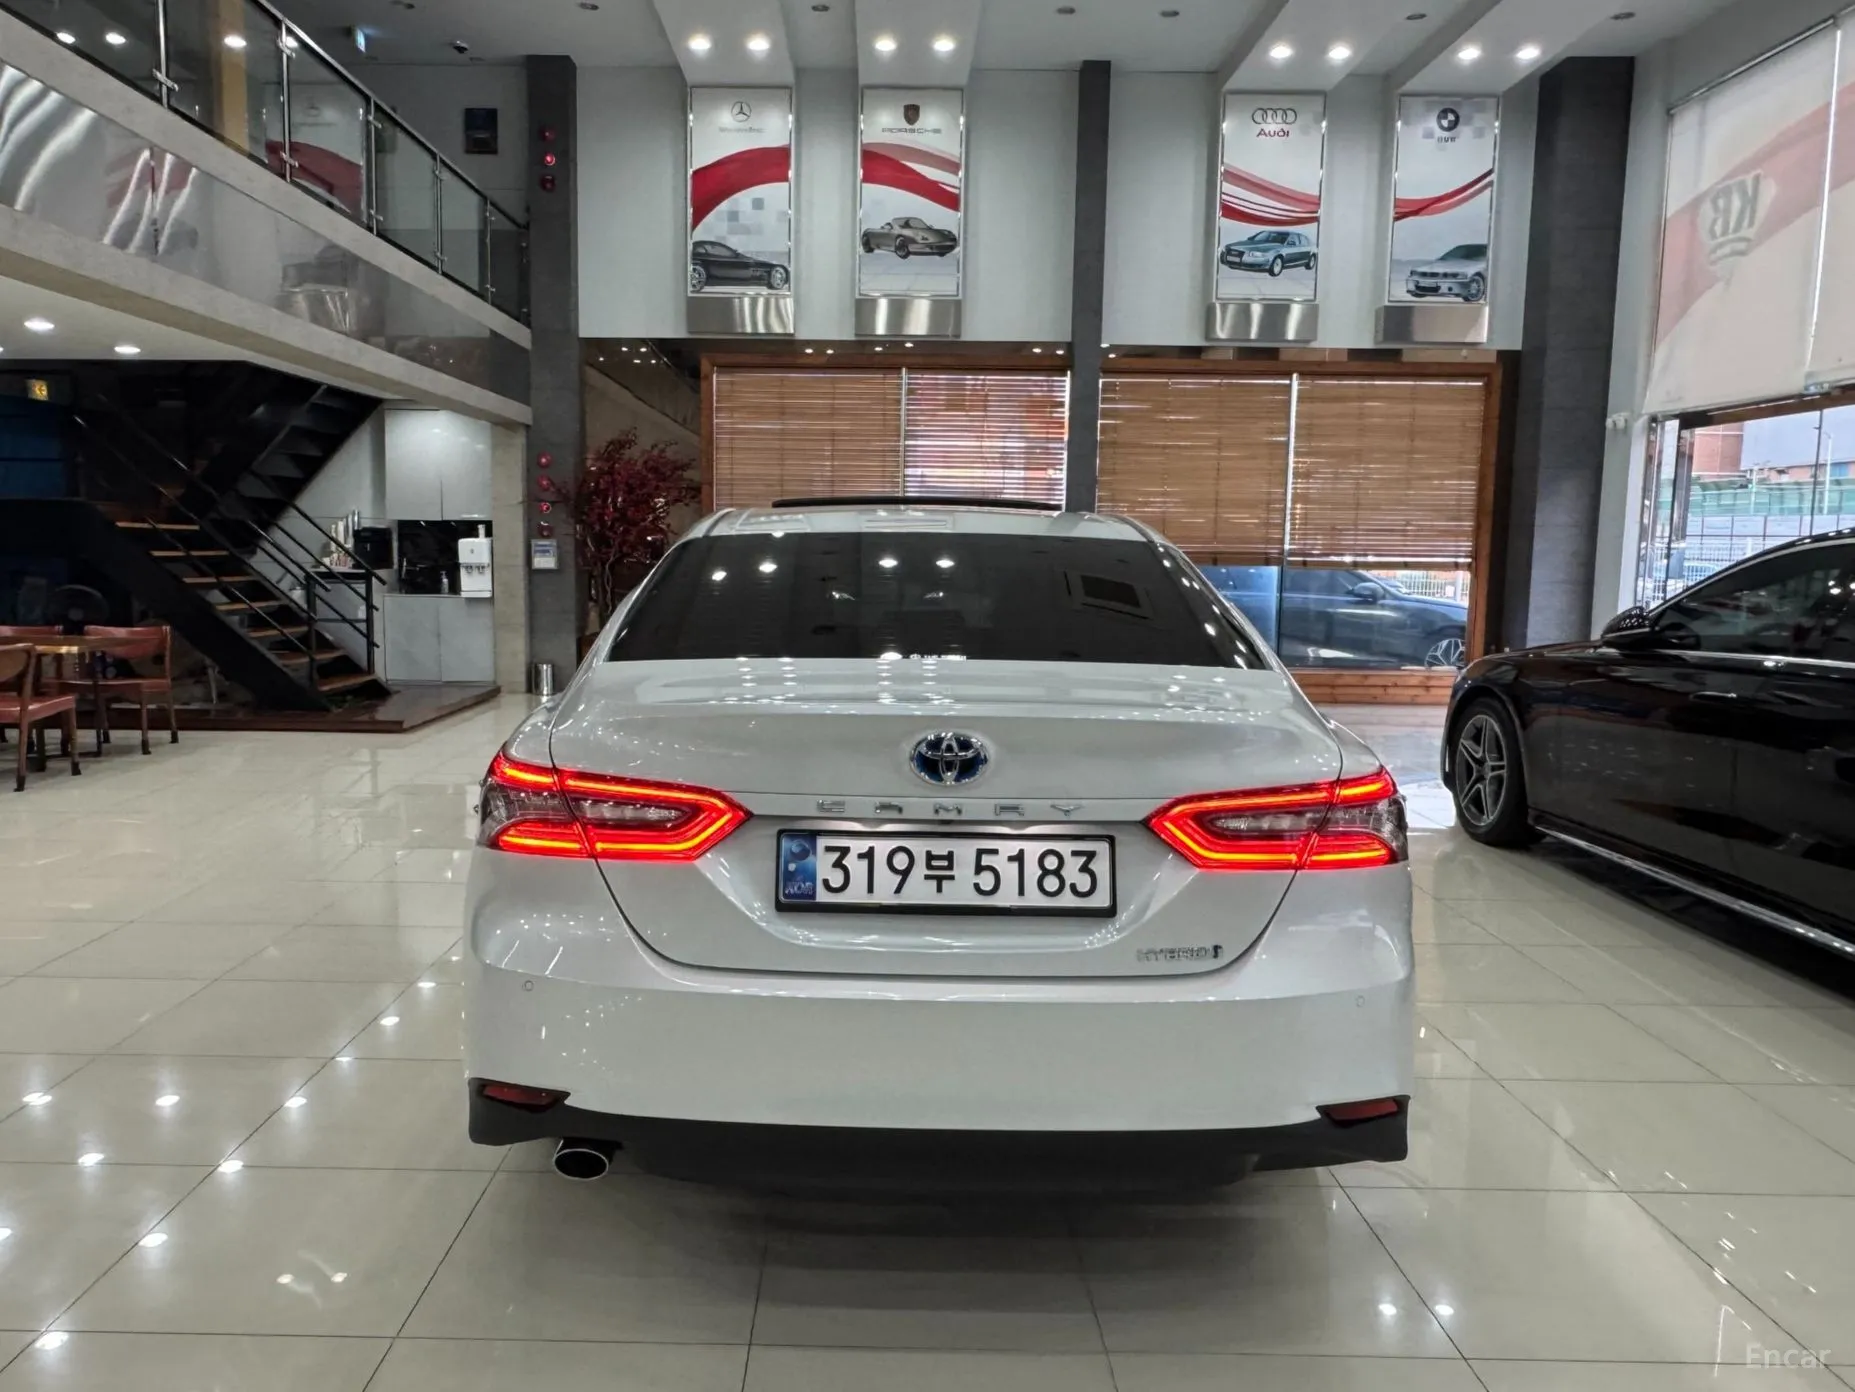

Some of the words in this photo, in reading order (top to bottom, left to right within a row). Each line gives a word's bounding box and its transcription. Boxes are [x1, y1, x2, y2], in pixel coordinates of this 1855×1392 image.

[1256, 128, 1290, 138] Audi
[816, 799, 1084, 817] CAMRY
[822, 845, 955, 895] 319부
[973, 848, 1098, 898] 5183
